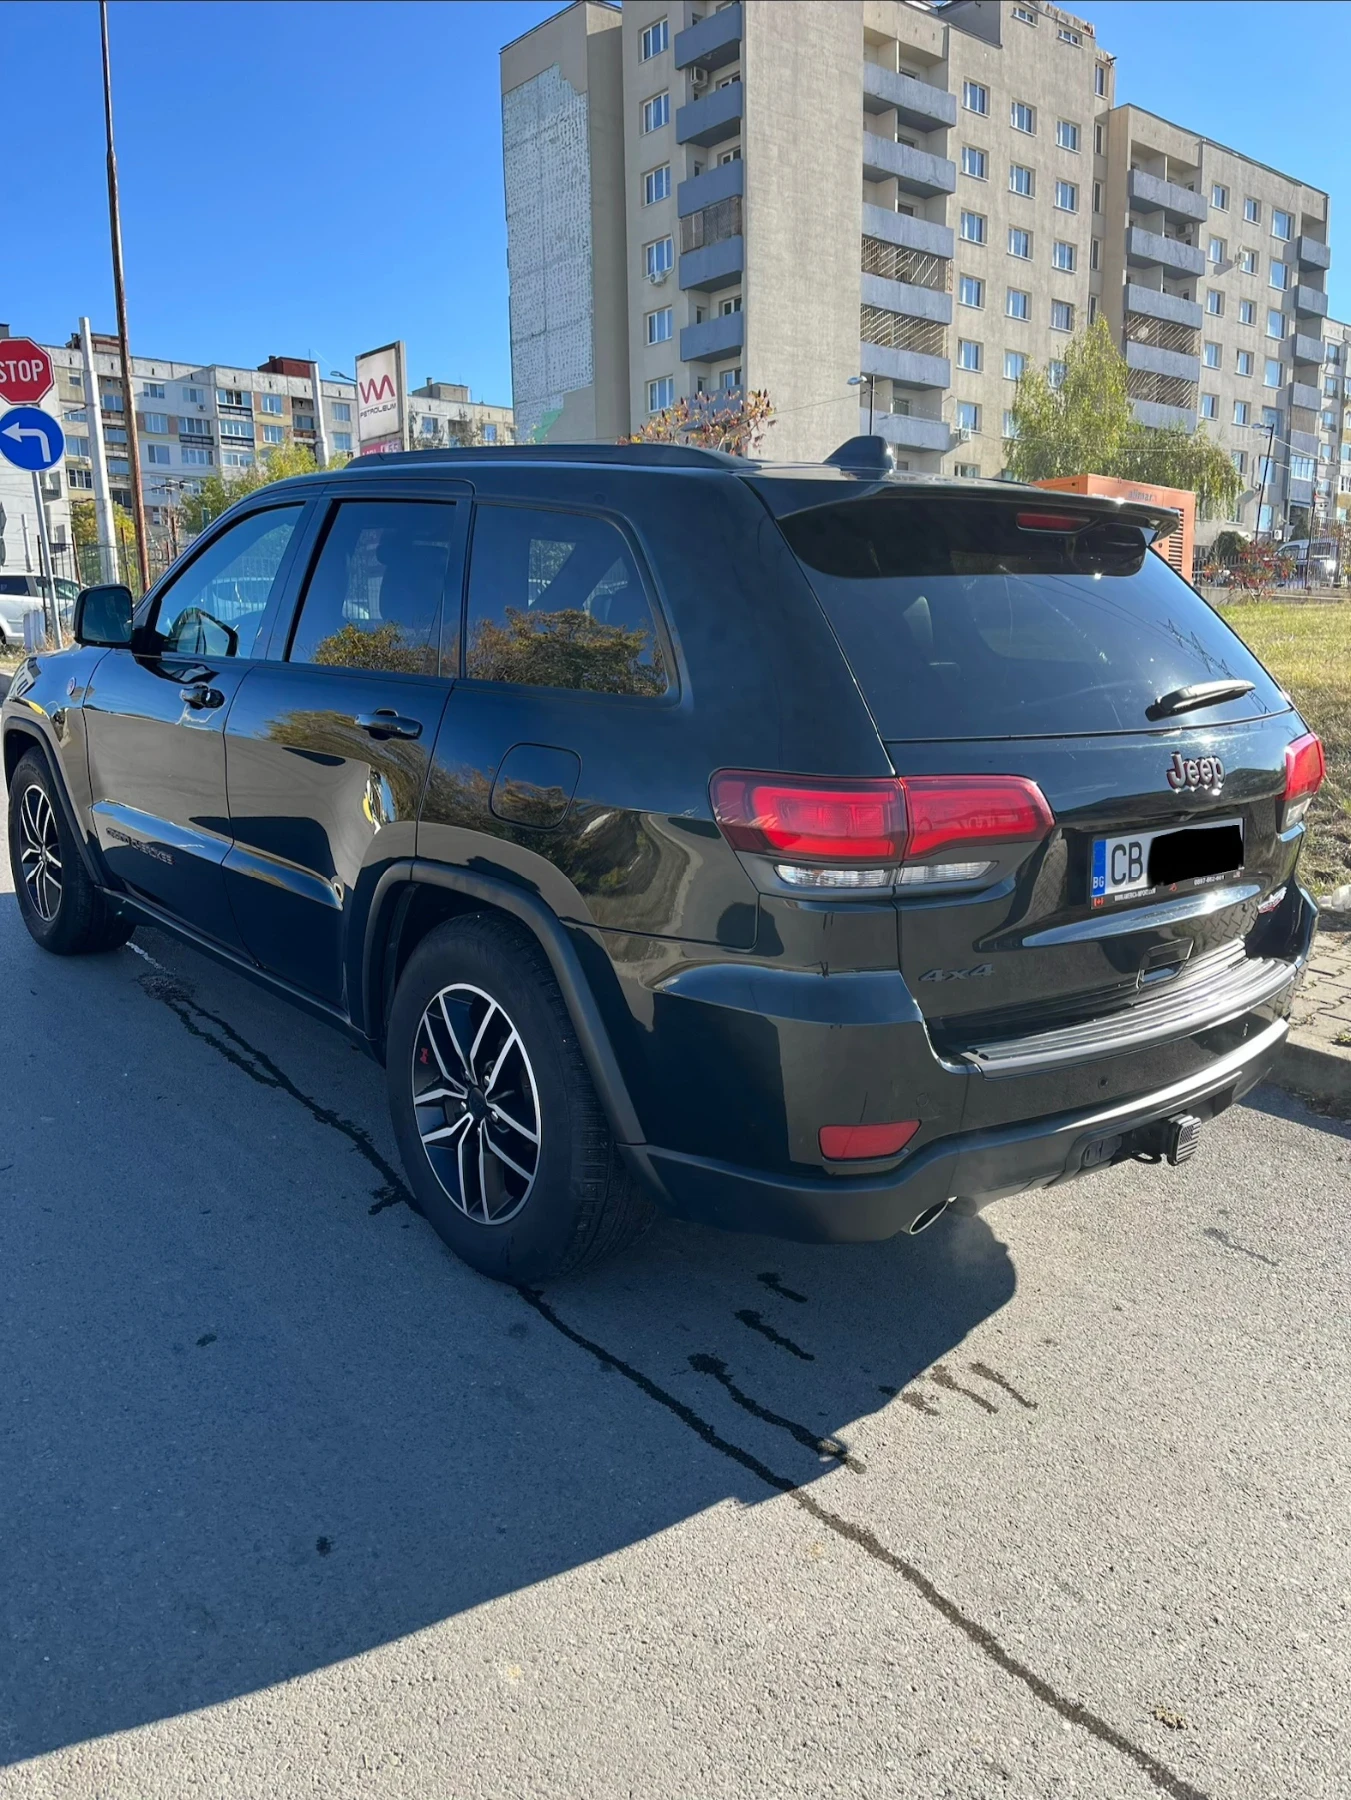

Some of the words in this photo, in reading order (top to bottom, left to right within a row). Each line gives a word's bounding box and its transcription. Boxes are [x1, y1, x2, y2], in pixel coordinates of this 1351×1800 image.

[0, 359, 44, 383] STOP
[360, 402, 397, 418] PETROLEUM
[1166, 751, 1226, 796] Jeep
[1092, 875, 1105, 889] BG
[918, 962, 995, 982] 4x4
